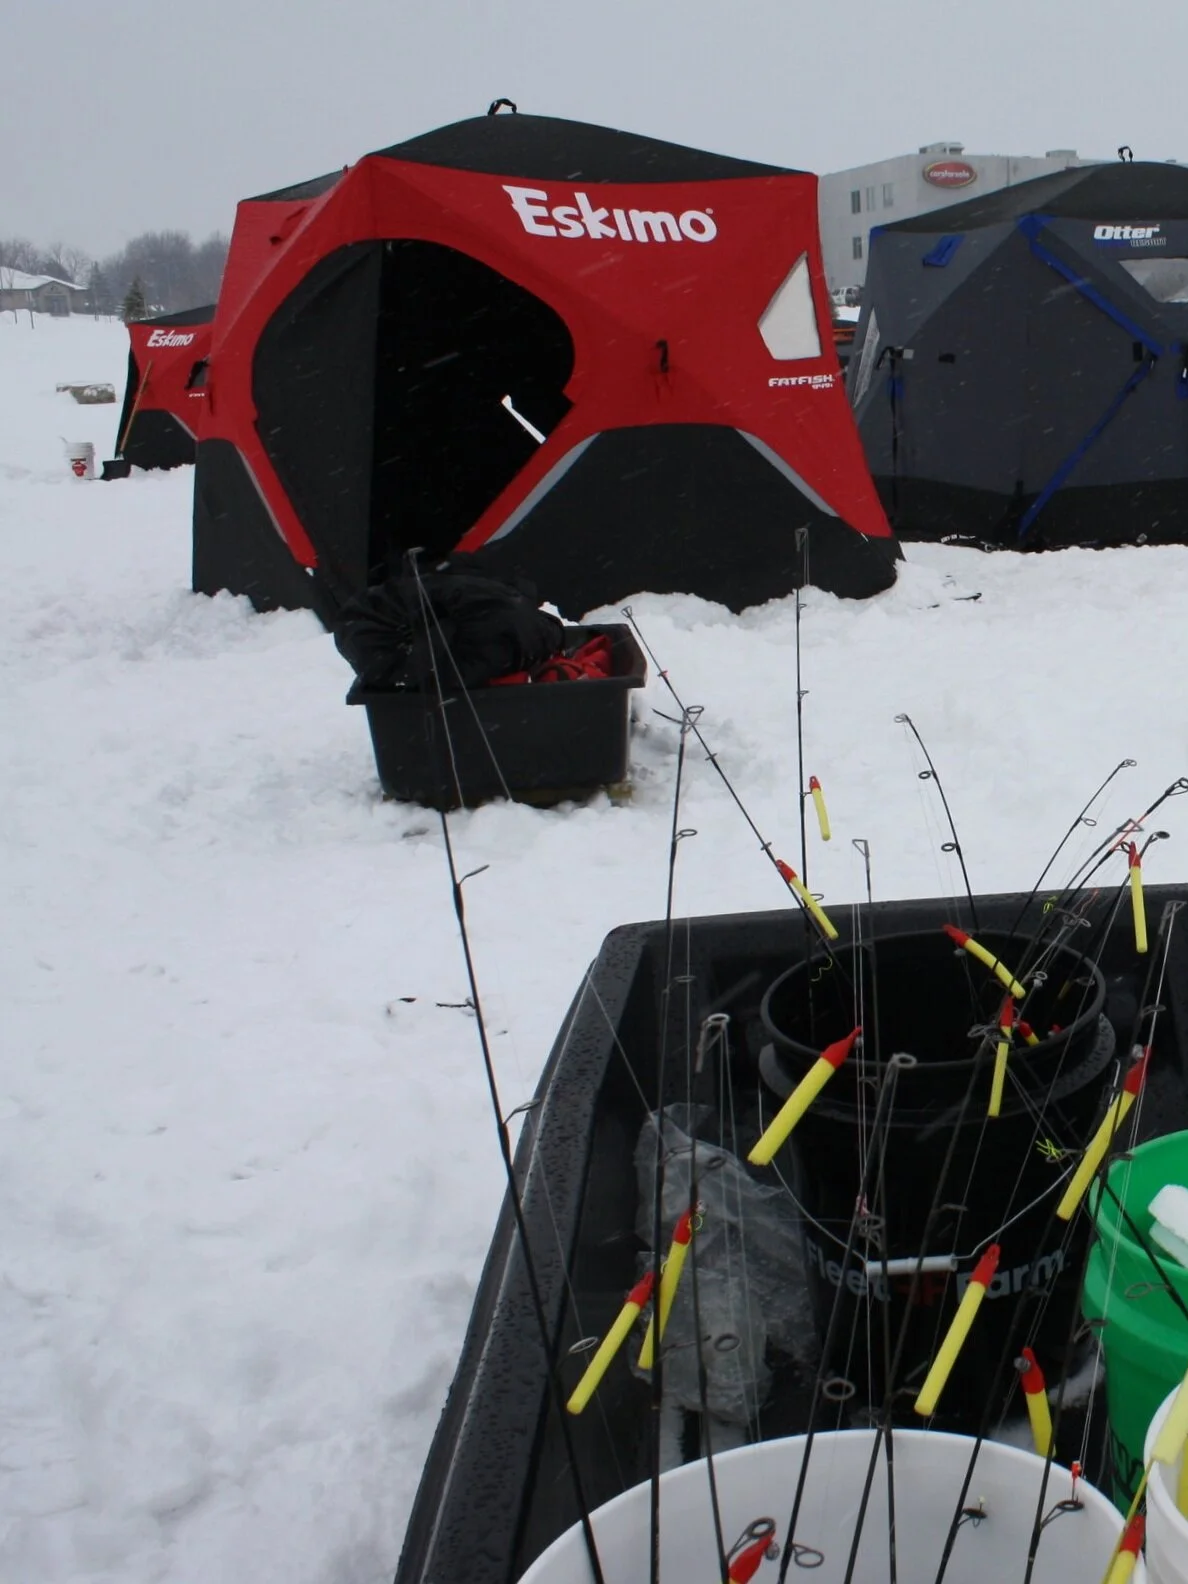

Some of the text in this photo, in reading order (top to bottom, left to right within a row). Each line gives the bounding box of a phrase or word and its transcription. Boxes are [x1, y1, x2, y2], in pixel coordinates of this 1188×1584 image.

[502, 185, 718, 243] Eskimo
[1093, 224, 1160, 240] Otter
[146, 329, 195, 347] Eskimo
[768, 374, 834, 387] FATFISH
